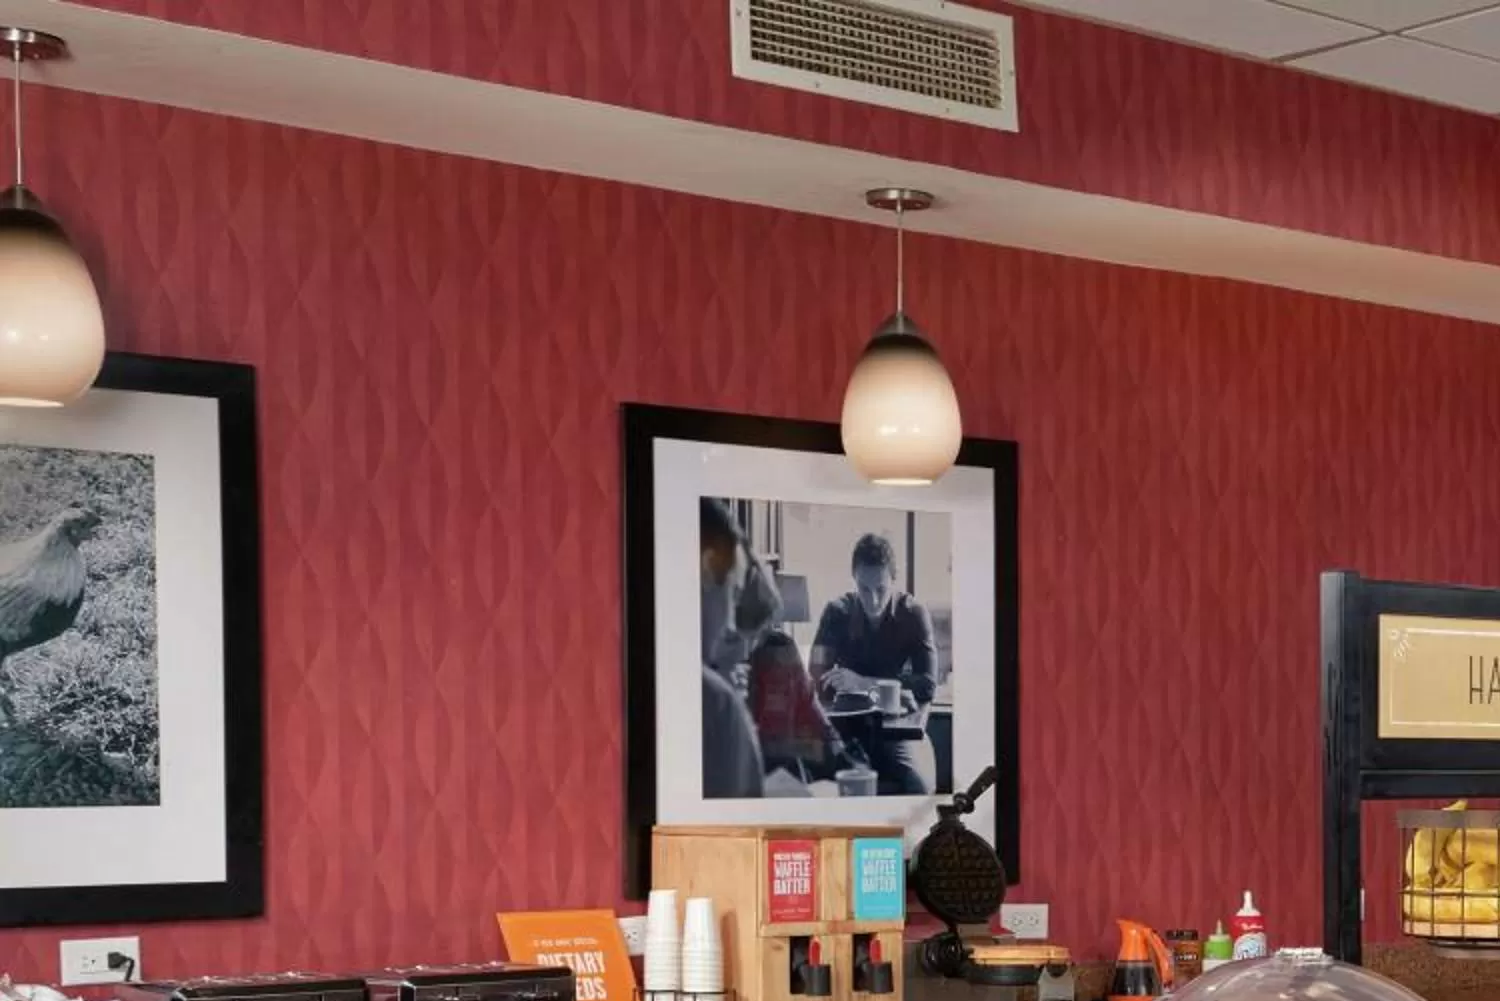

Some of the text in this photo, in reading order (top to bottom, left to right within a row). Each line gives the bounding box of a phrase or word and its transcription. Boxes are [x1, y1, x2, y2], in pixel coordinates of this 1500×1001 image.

[773, 860, 812, 876] WAFFLE
[773, 877, 812, 895] BATTER
[575, 976, 608, 1001] EDS
